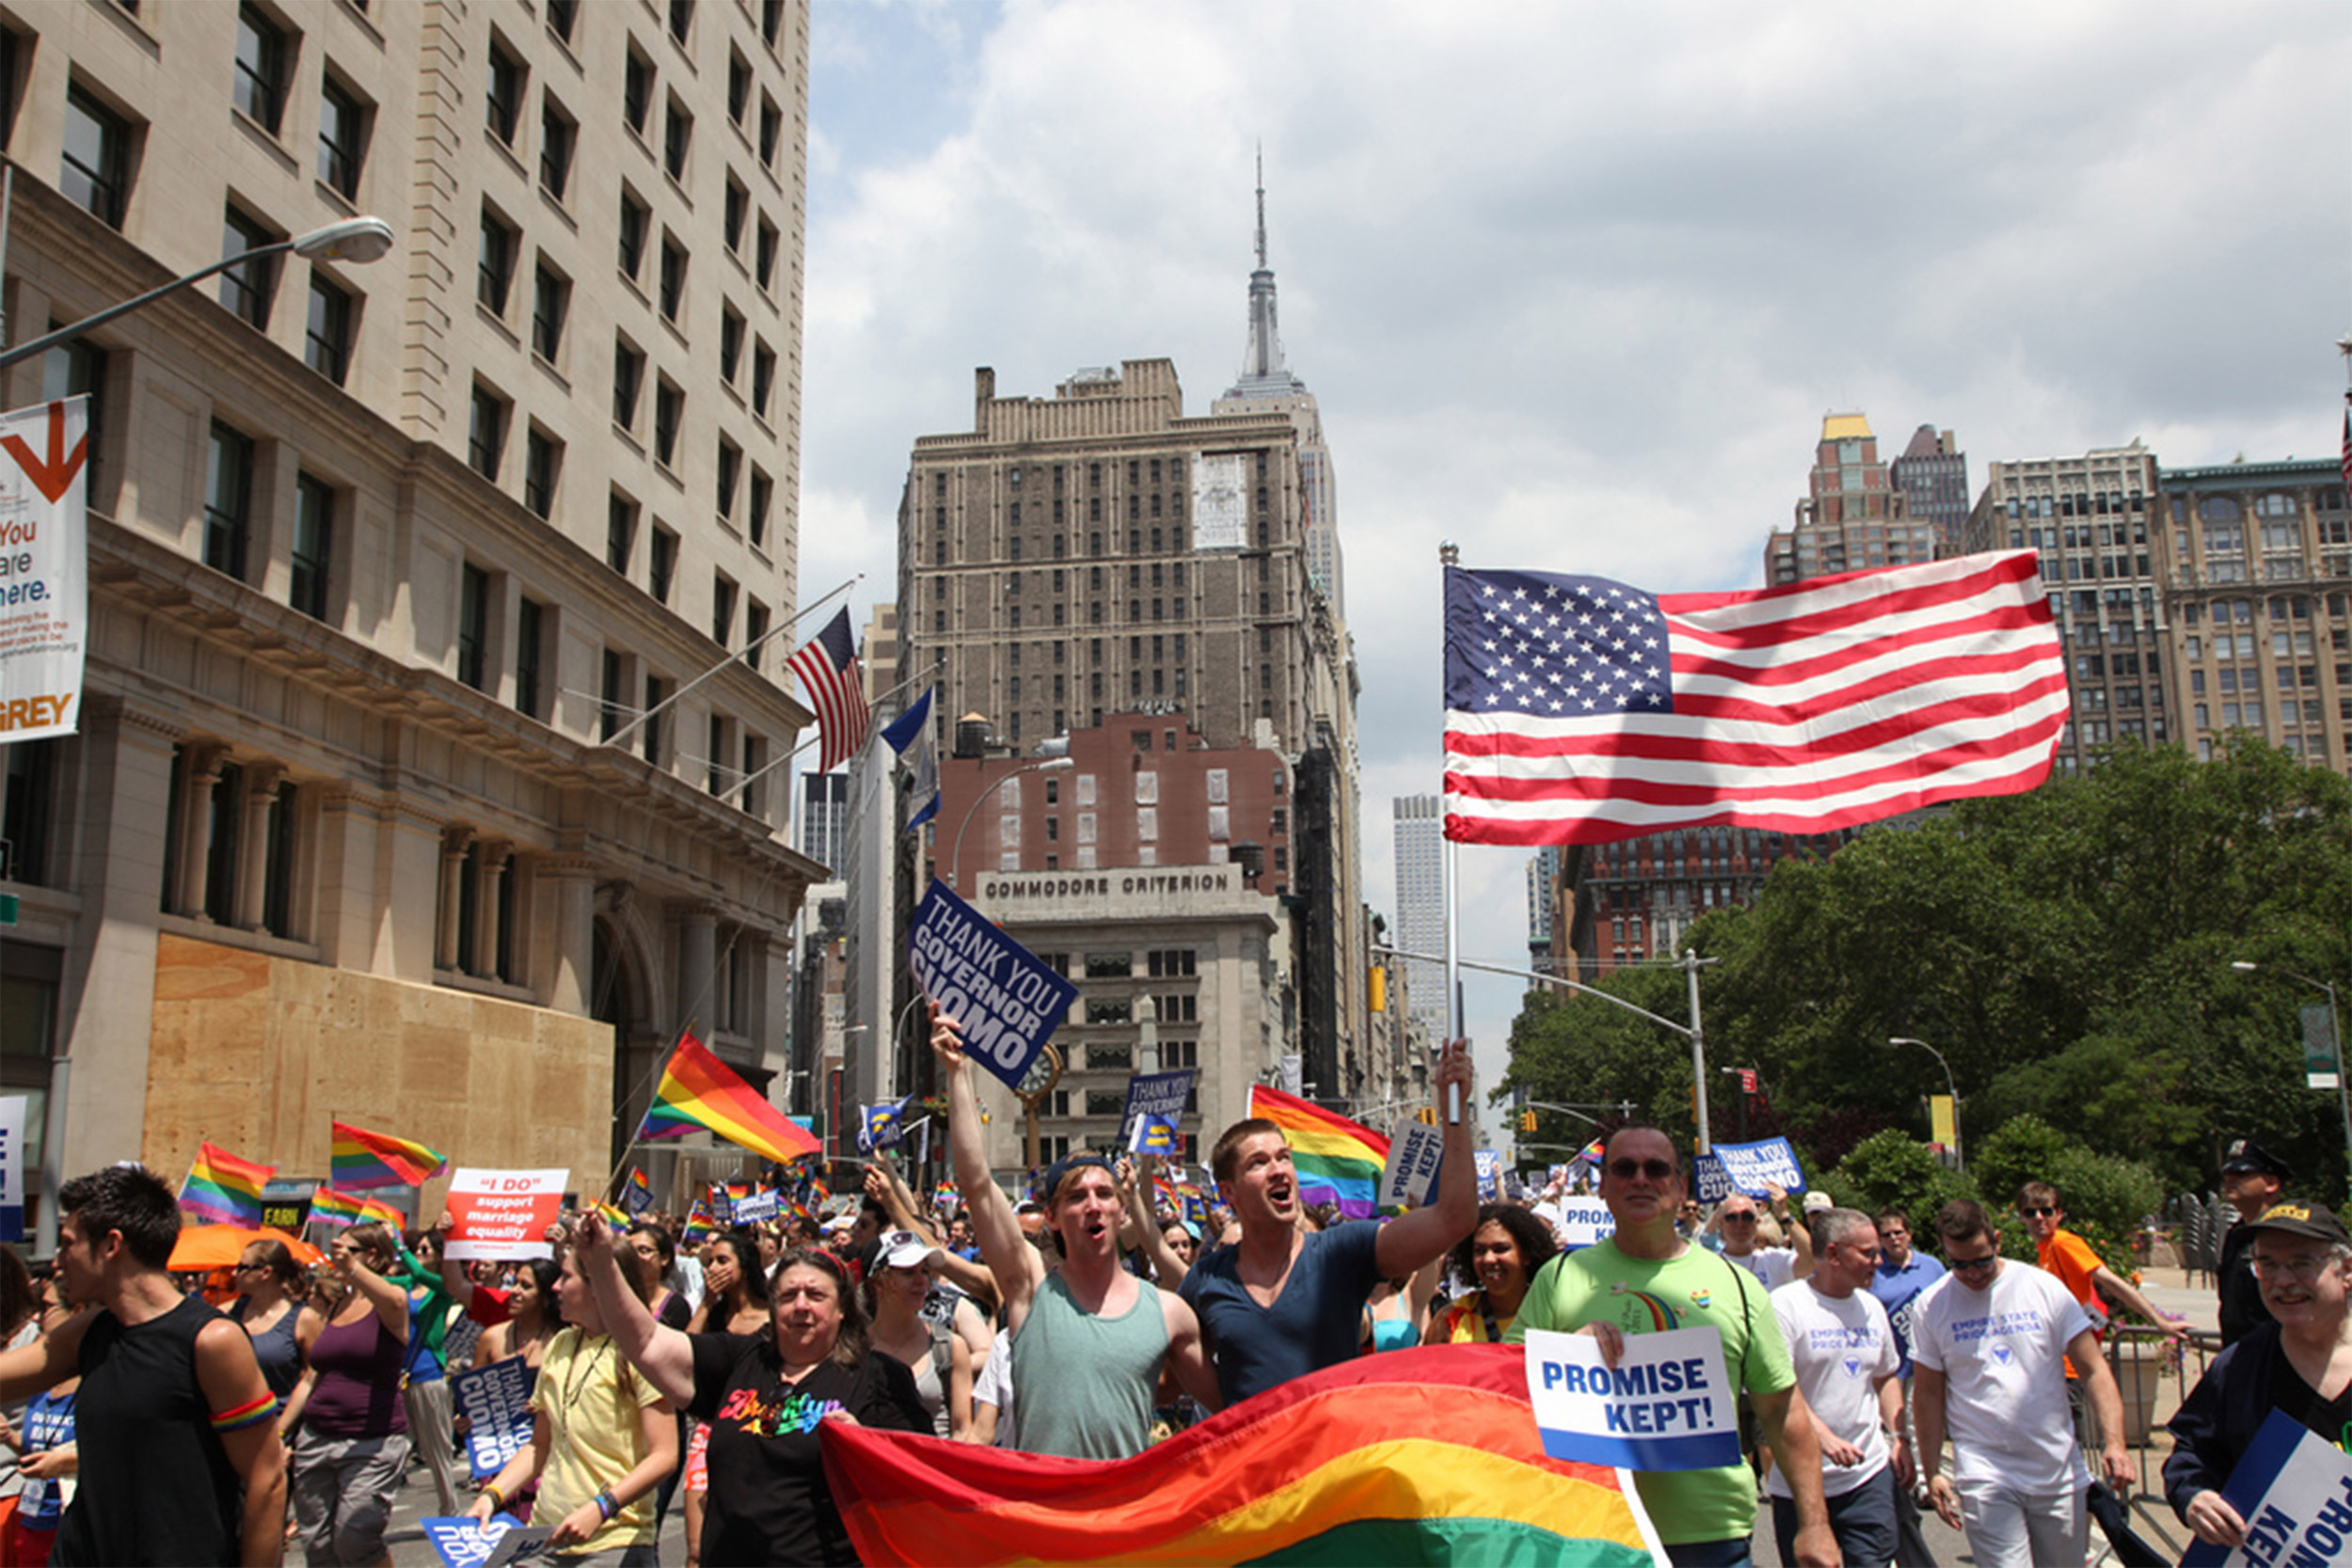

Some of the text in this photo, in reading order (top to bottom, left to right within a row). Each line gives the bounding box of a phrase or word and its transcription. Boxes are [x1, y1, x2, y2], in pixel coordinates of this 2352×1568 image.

[985, 874, 1229, 899] COMMODORE CRITERION
[926, 894, 1062, 1017] THANK YOU
[914, 924, 1042, 1040] GOVERNOR
[911, 947, 1028, 1070] CUOMO
[1132, 1081, 1169, 1101] THANK
[1391, 1128, 1426, 1197] PROMISE
[1415, 1132, 1444, 1179] KEPT!
[1717, 1142, 1788, 1165] THANK YOU
[1733, 1169, 1802, 1192] CUOMO
[466, 1211, 534, 1226] marriage
[476, 1196, 534, 1211] support
[466, 1226, 527, 1241] equality
[1999, 1310, 2038, 1324] STATE
[500, 1362, 531, 1418] THANK
[1541, 1358, 1709, 1397] PROMISE
[458, 1374, 502, 1470] CUOMO
[483, 1369, 517, 1464] GOVERNOR
[1604, 1396, 1715, 1433] KEPT!
